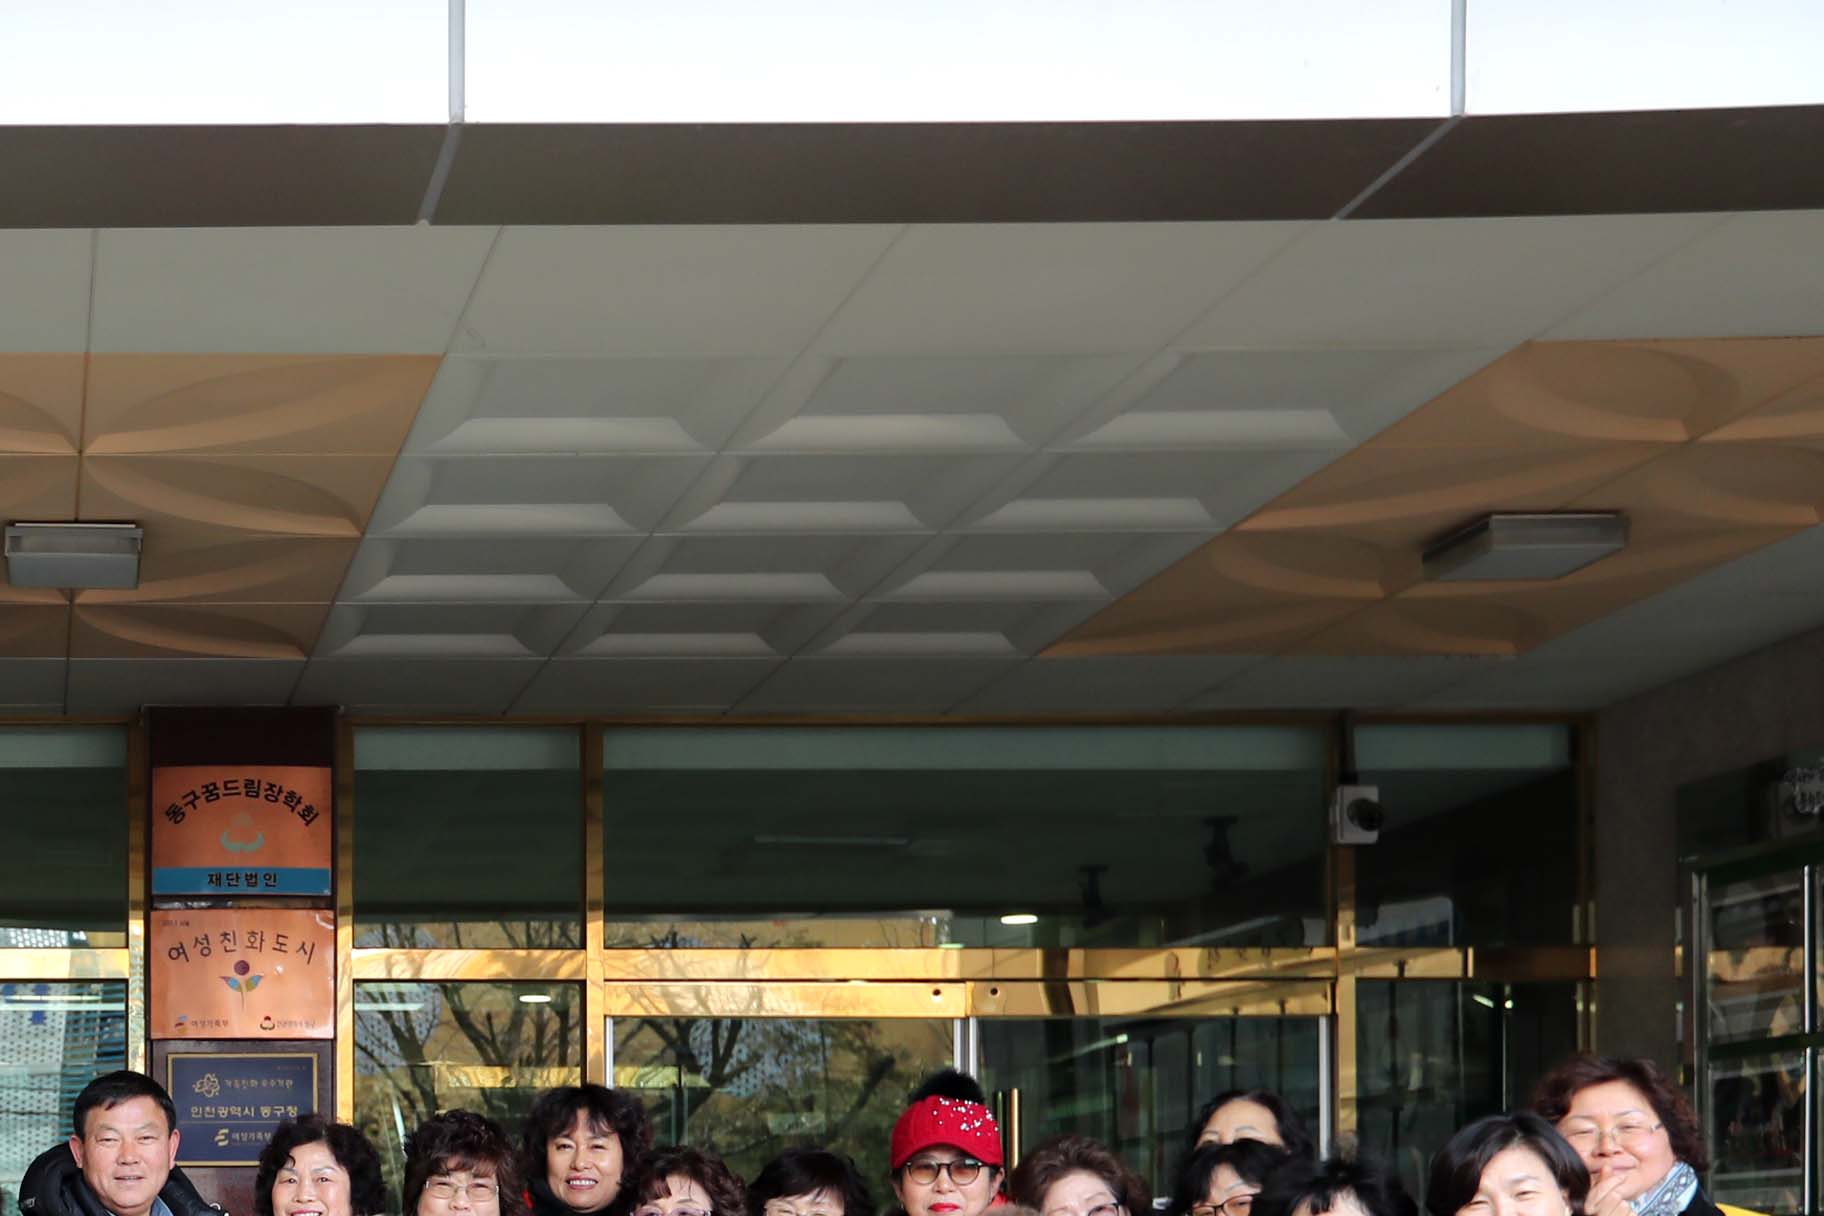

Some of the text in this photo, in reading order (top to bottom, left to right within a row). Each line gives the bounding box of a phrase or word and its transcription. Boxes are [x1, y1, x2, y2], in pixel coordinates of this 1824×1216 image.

[165, 778, 320, 827] 동구꿈드림장학회
[207, 872, 277, 888] 재단법인
[168, 930, 316, 965] 여성친화도시
[190, 1105, 299, 1118] 인천광역시 동구청
